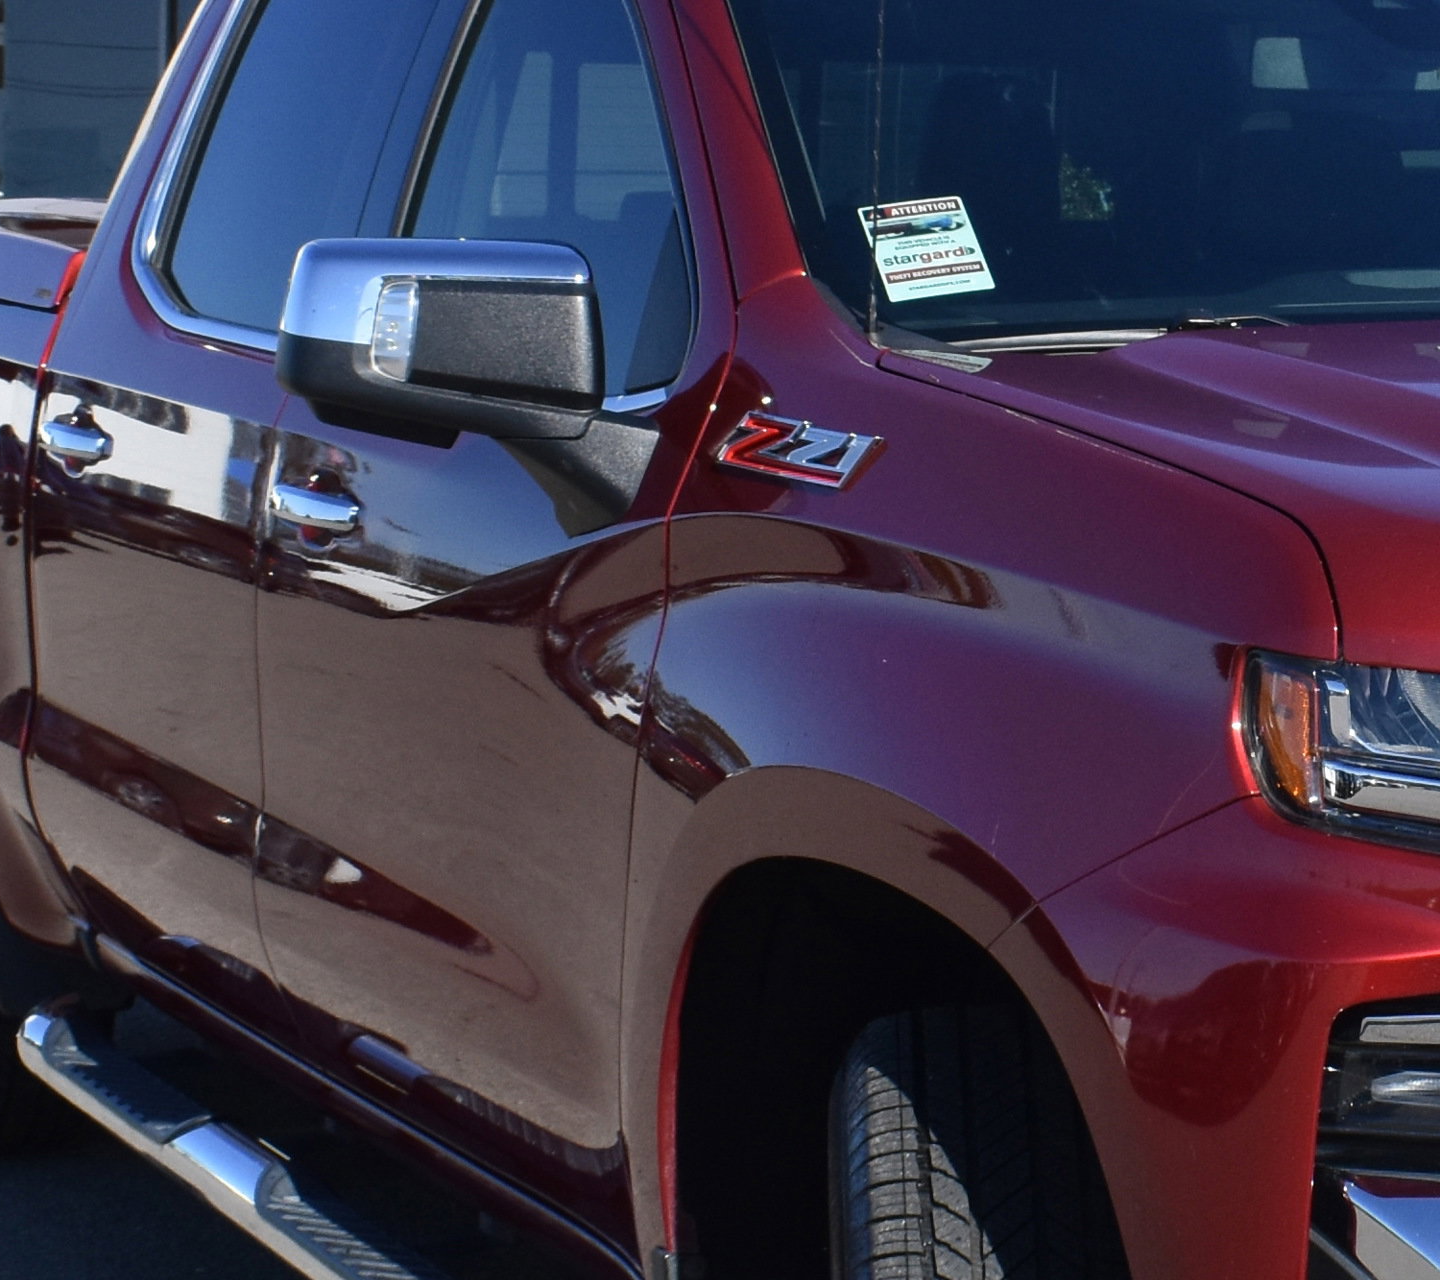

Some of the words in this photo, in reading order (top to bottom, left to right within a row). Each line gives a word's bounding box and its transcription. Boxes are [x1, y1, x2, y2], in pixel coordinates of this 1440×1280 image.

[891, 201, 957, 216] ATTENTION
[883, 246, 965, 266] stargard
[912, 267, 951, 278] RECOVERY
[952, 263, 981, 274] SYSTEM
[716, 410, 885, 489] Z71
